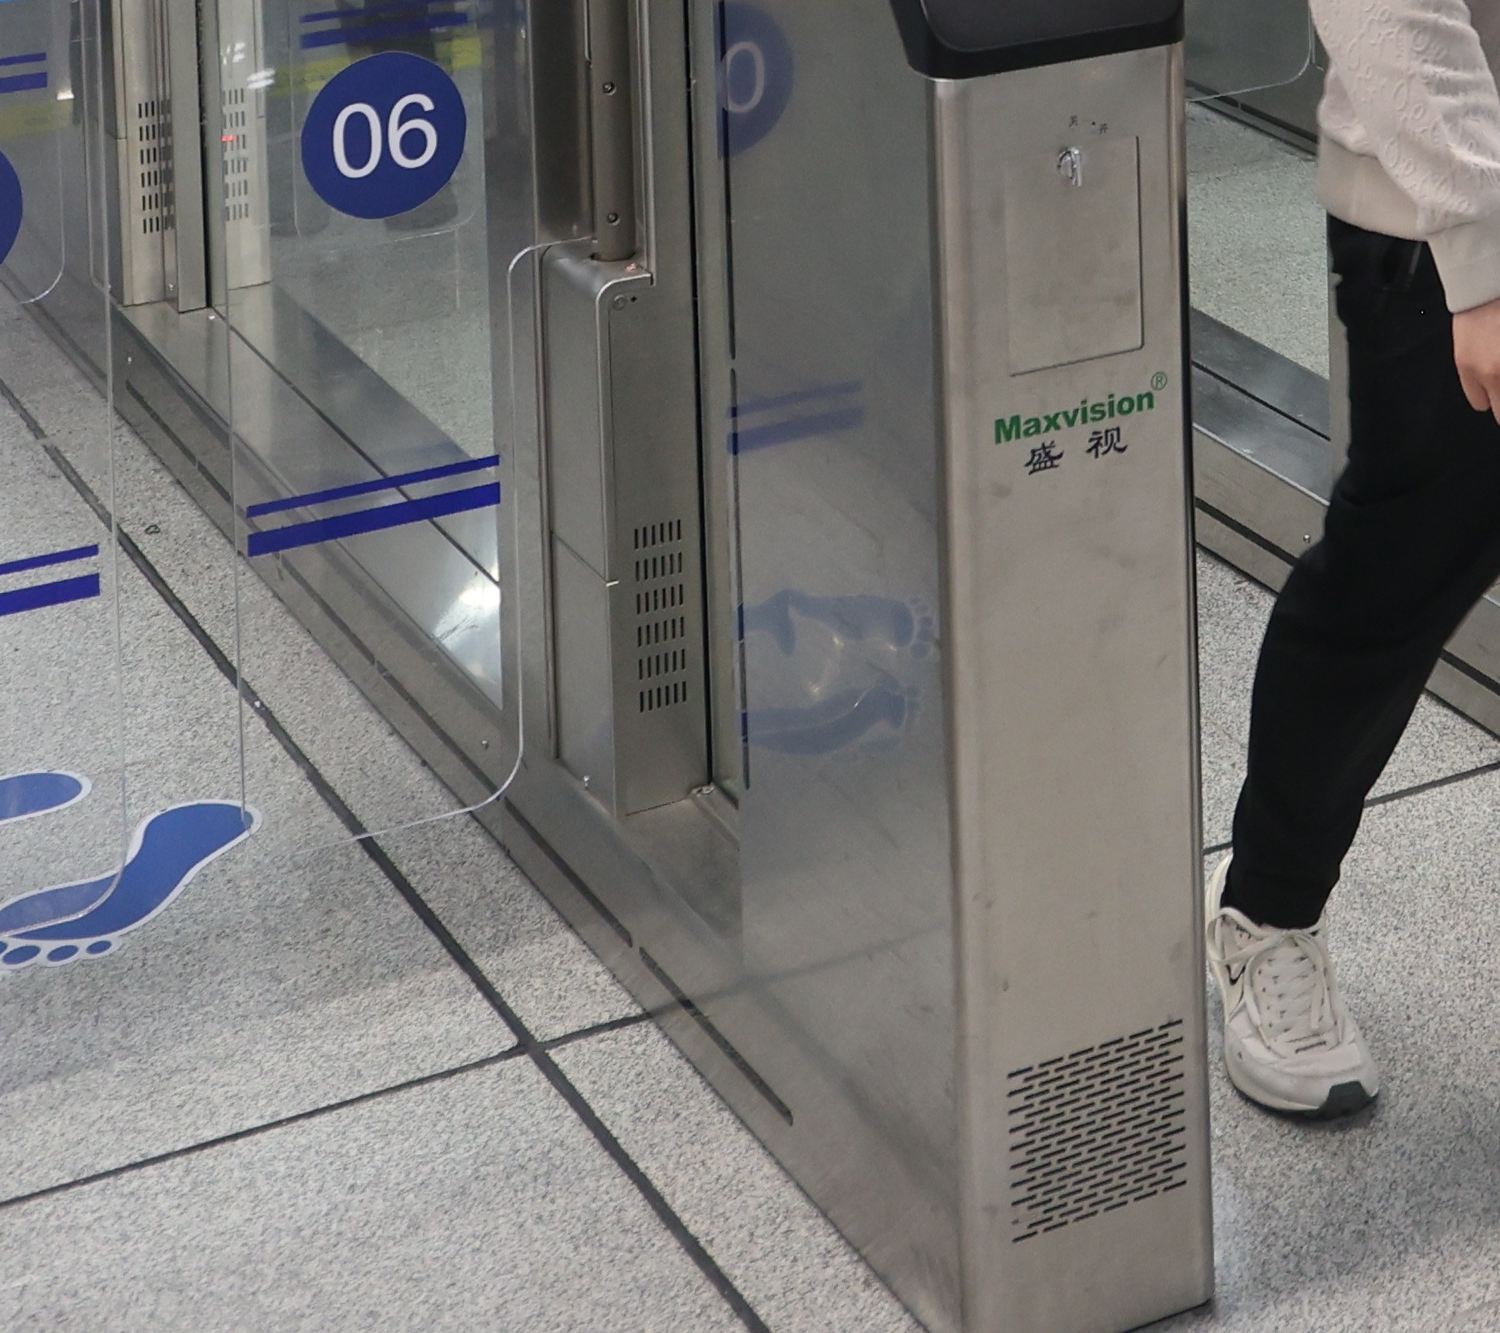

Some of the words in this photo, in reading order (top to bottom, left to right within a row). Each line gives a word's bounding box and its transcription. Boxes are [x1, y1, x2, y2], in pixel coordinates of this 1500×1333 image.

[331, 91, 439, 179] 06
[994, 387, 1155, 445] Maxvision
[1023, 427, 1128, 475] 盛视
